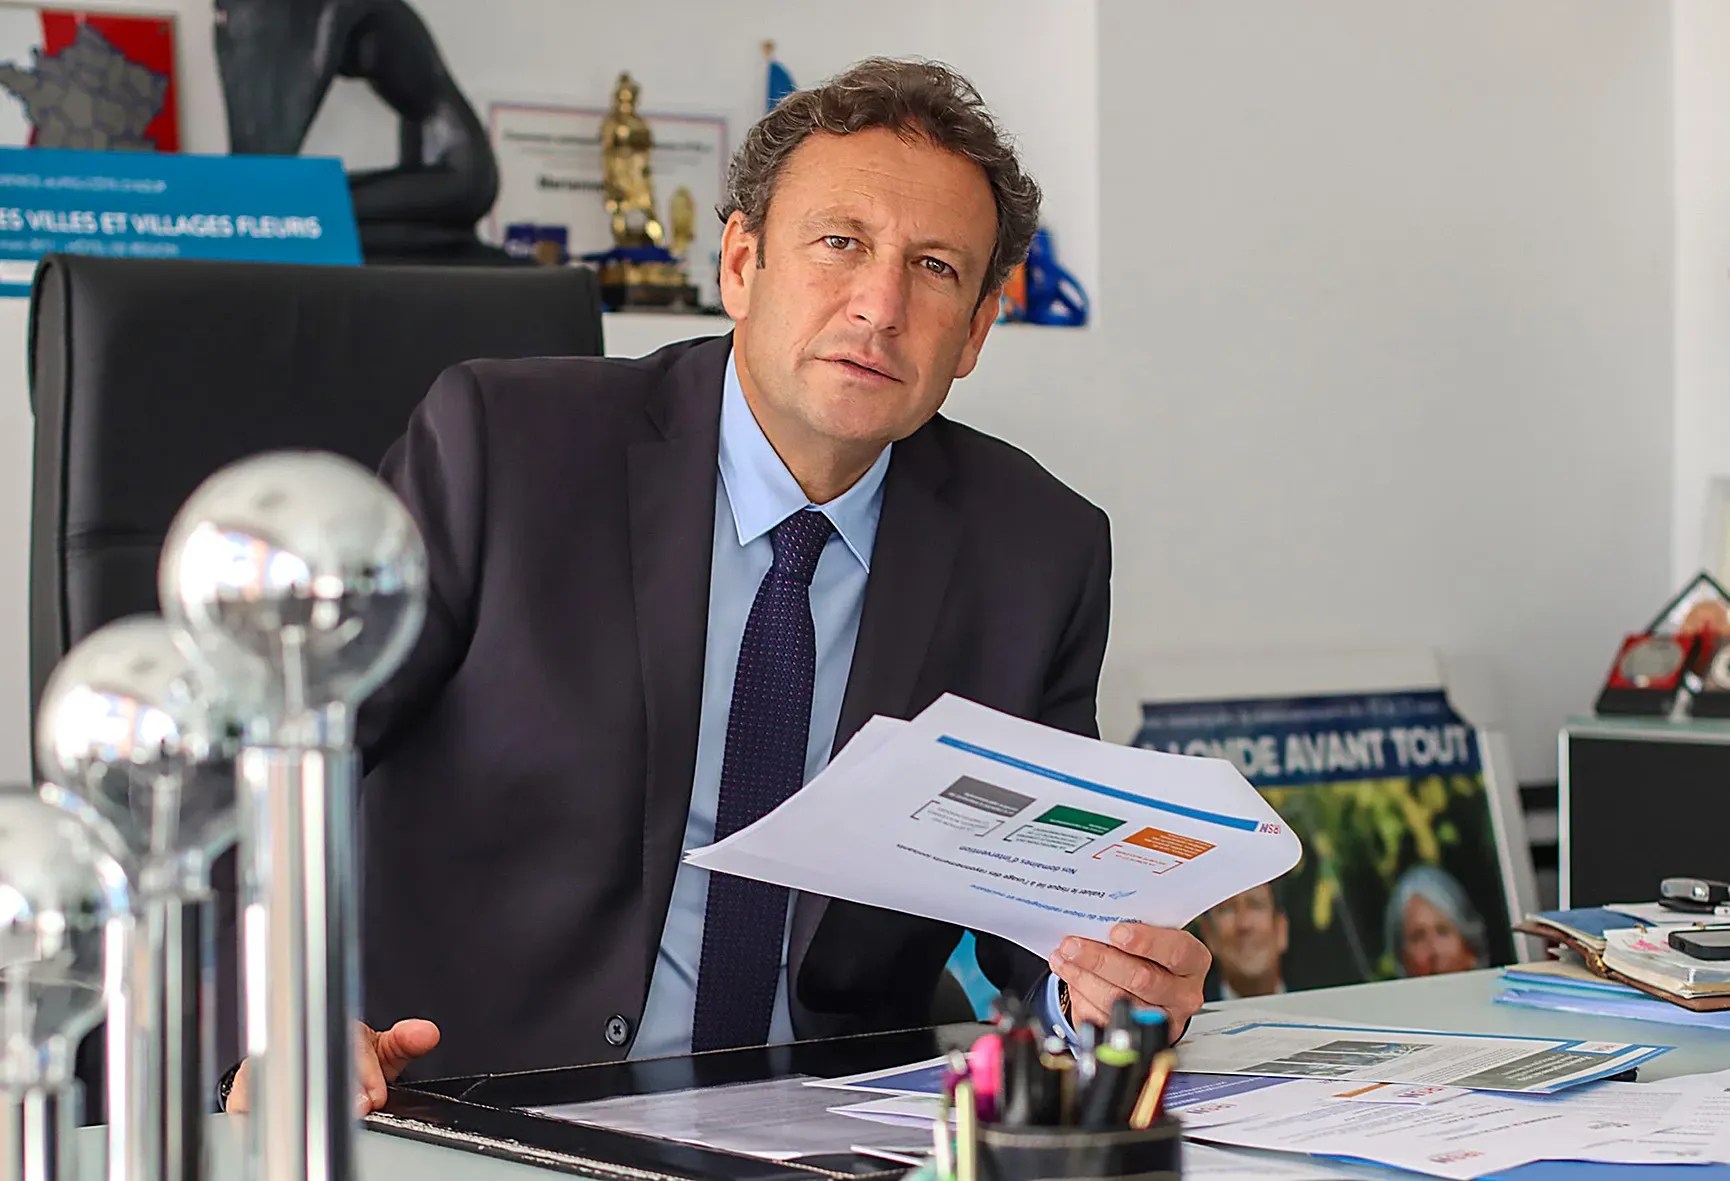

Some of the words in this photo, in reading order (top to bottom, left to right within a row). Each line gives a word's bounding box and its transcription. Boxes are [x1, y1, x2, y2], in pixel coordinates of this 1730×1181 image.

[0, 207, 24, 231] ES
[25, 209, 98, 234] VILLES
[100, 211, 129, 235] ET
[130, 213, 233, 238] VILLAGES
[236, 215, 323, 239] FLEURIS
[1284, 732, 1384, 773] AVANT
[1390, 725, 1470, 765] TOUT
[958, 845, 1019, 863] d'intervention
[1020, 858, 1061, 872] domaines
[1061, 866, 1078, 875] Nos
[1047, 883, 1070, 893] risque
[1063, 909, 1087, 918] risque
